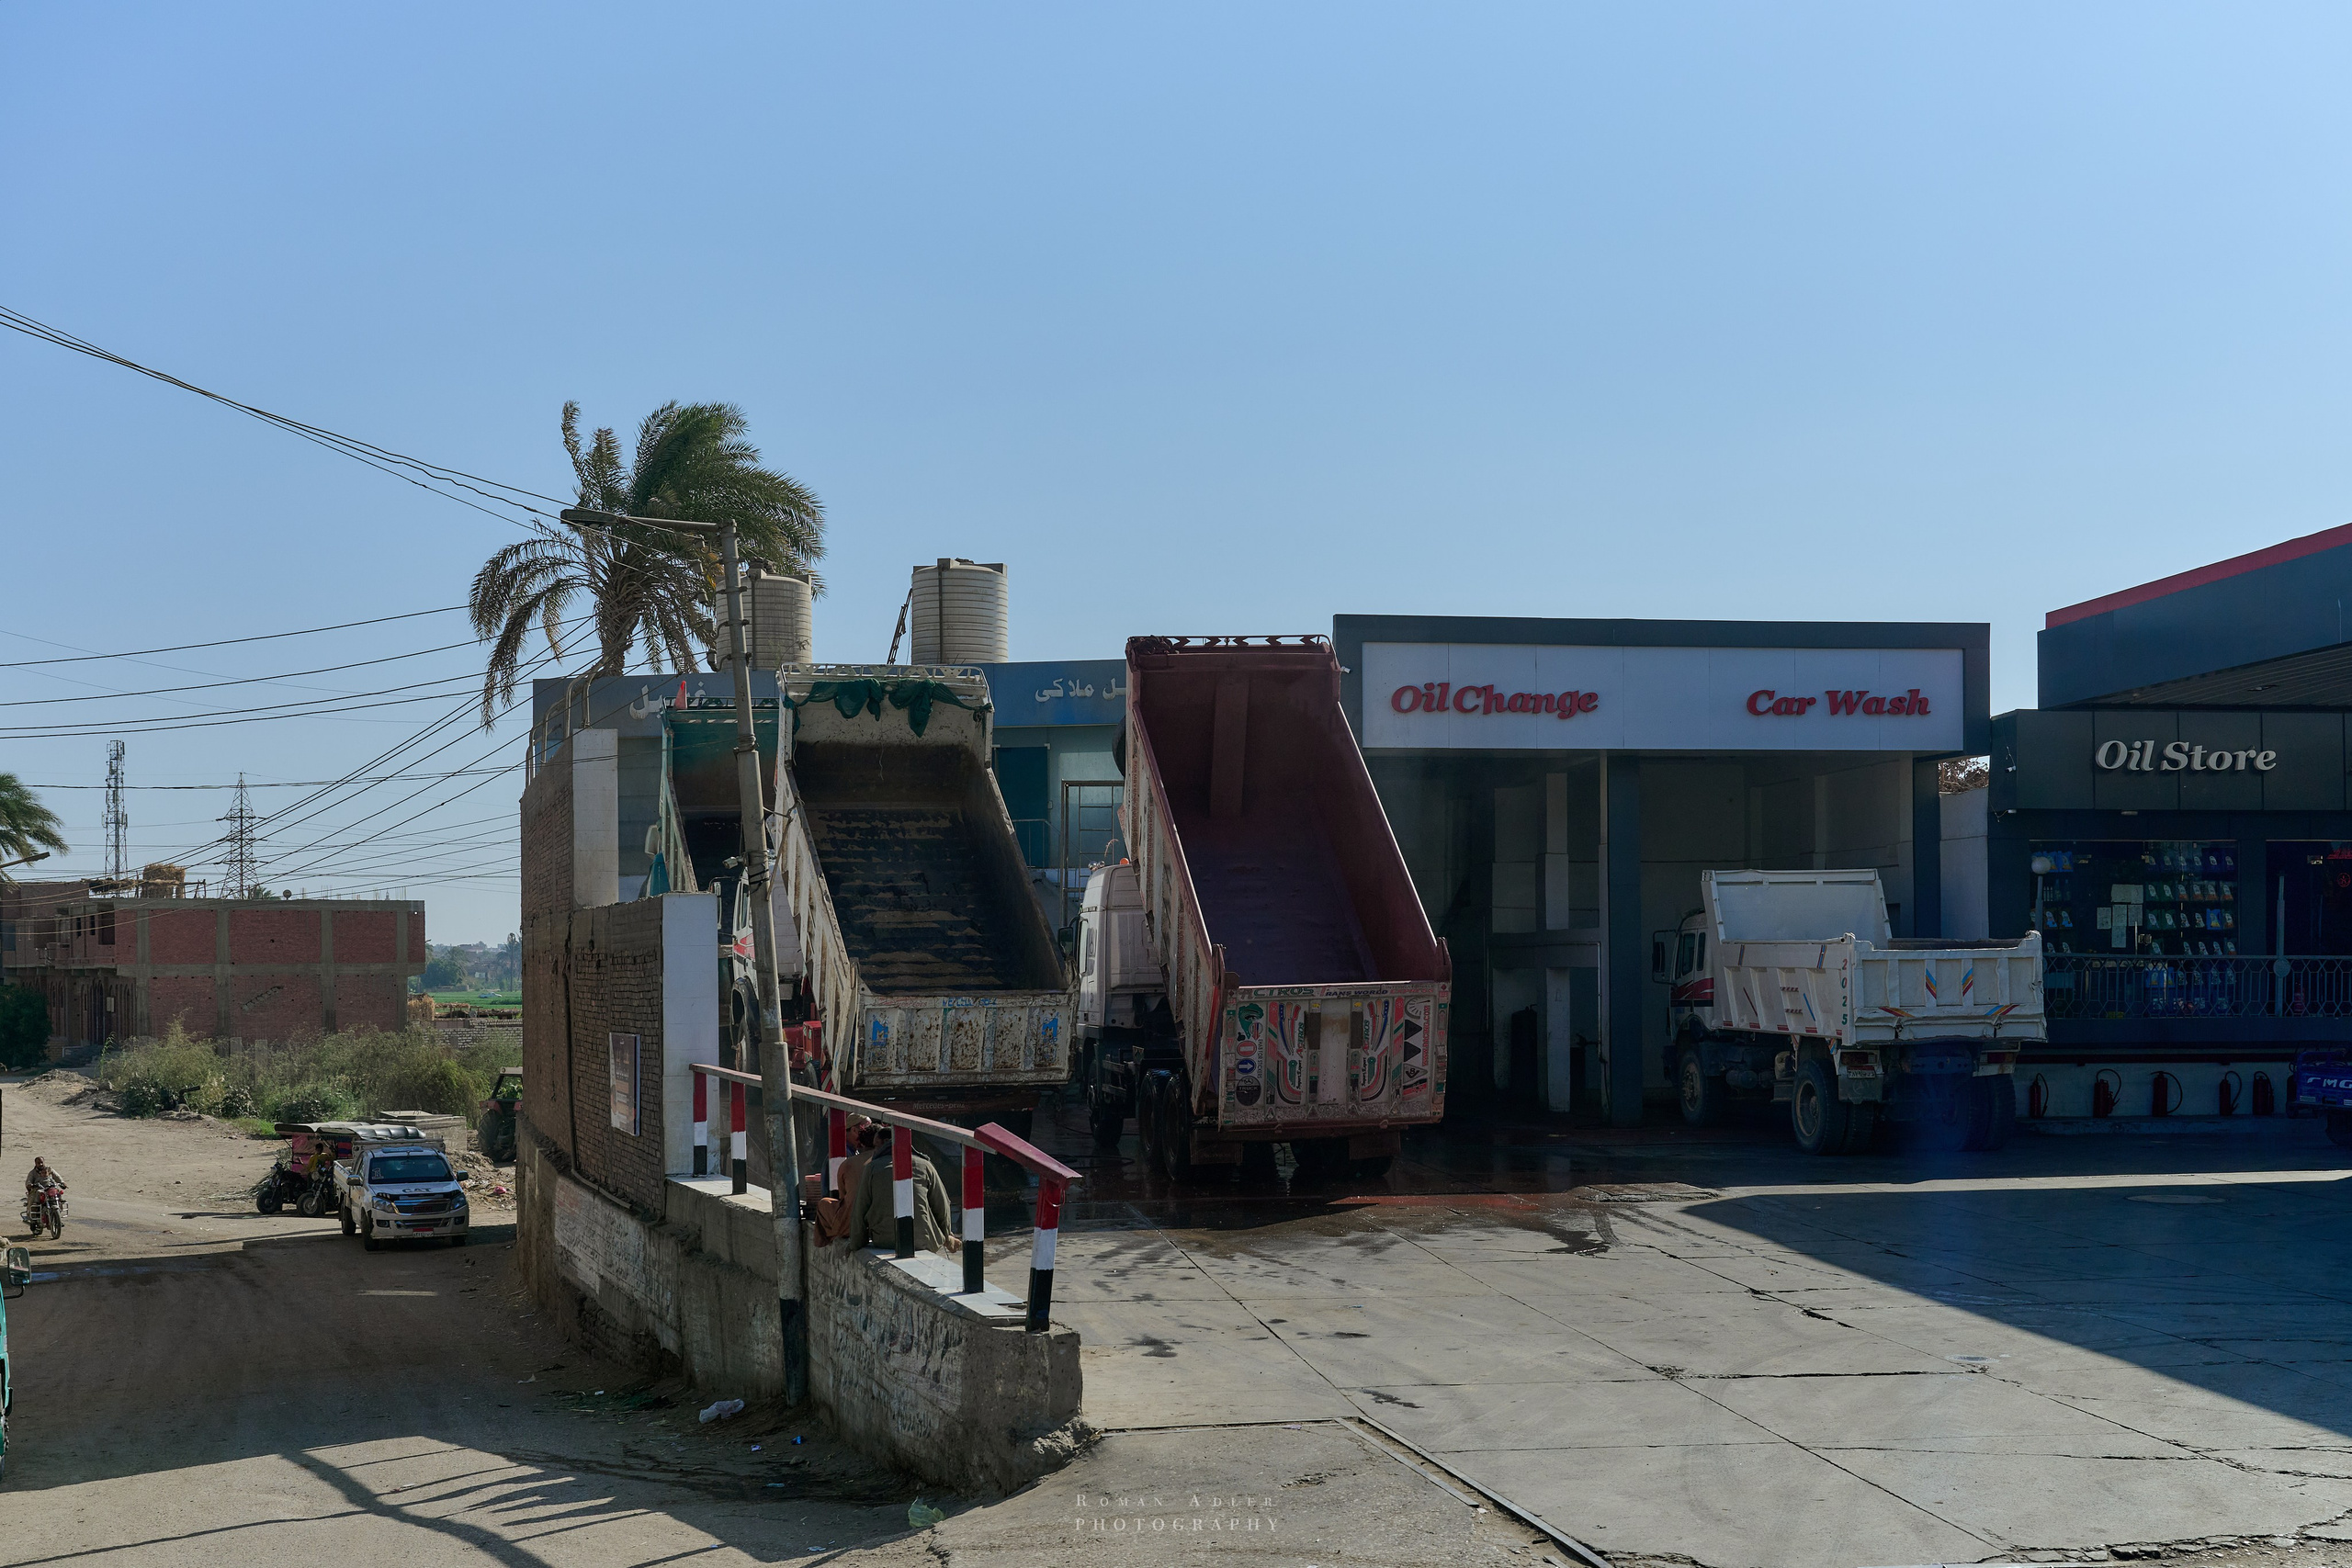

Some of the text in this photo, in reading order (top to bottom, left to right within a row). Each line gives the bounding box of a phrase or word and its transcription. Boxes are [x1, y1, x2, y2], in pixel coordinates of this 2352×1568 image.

[1391, 682, 1599, 719] Oil Change
[1747, 688, 1931, 716] Car Wash
[2095, 739, 2278, 773] Oil Store
